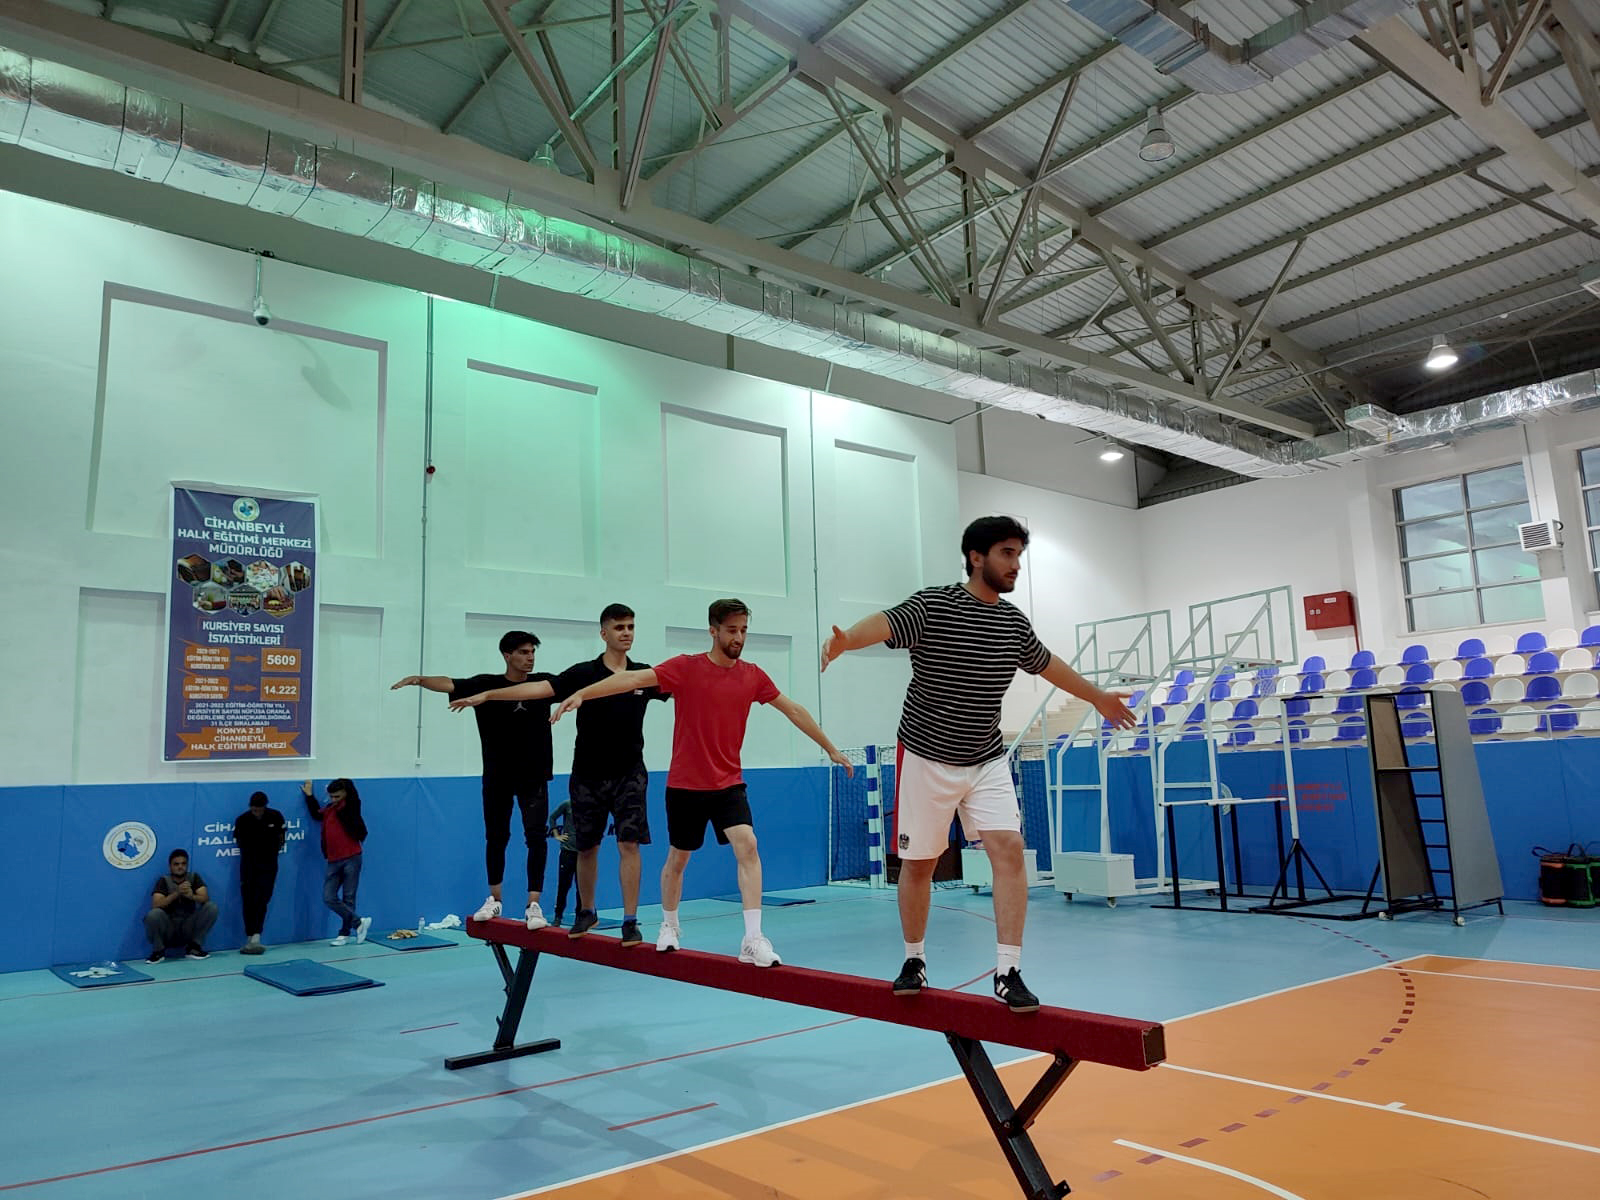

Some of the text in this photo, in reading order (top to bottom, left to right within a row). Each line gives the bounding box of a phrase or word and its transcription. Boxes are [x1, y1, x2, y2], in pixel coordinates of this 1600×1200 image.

[204, 516, 285, 535] CİHANBEYLİ
[178, 528, 312, 549] HALK EĞİTİMİ MERKEZİ
[209, 543, 284, 558] MÜDÜRLÜĞÜ
[202, 621, 284, 634] KURSİYER SAYISI
[208, 633, 281, 645] İSTATİSTİKLERİ
[267, 655, 296, 666] 5609
[264, 686, 297, 695] 14.222
[249, 741, 287, 750] MERKEZİ
